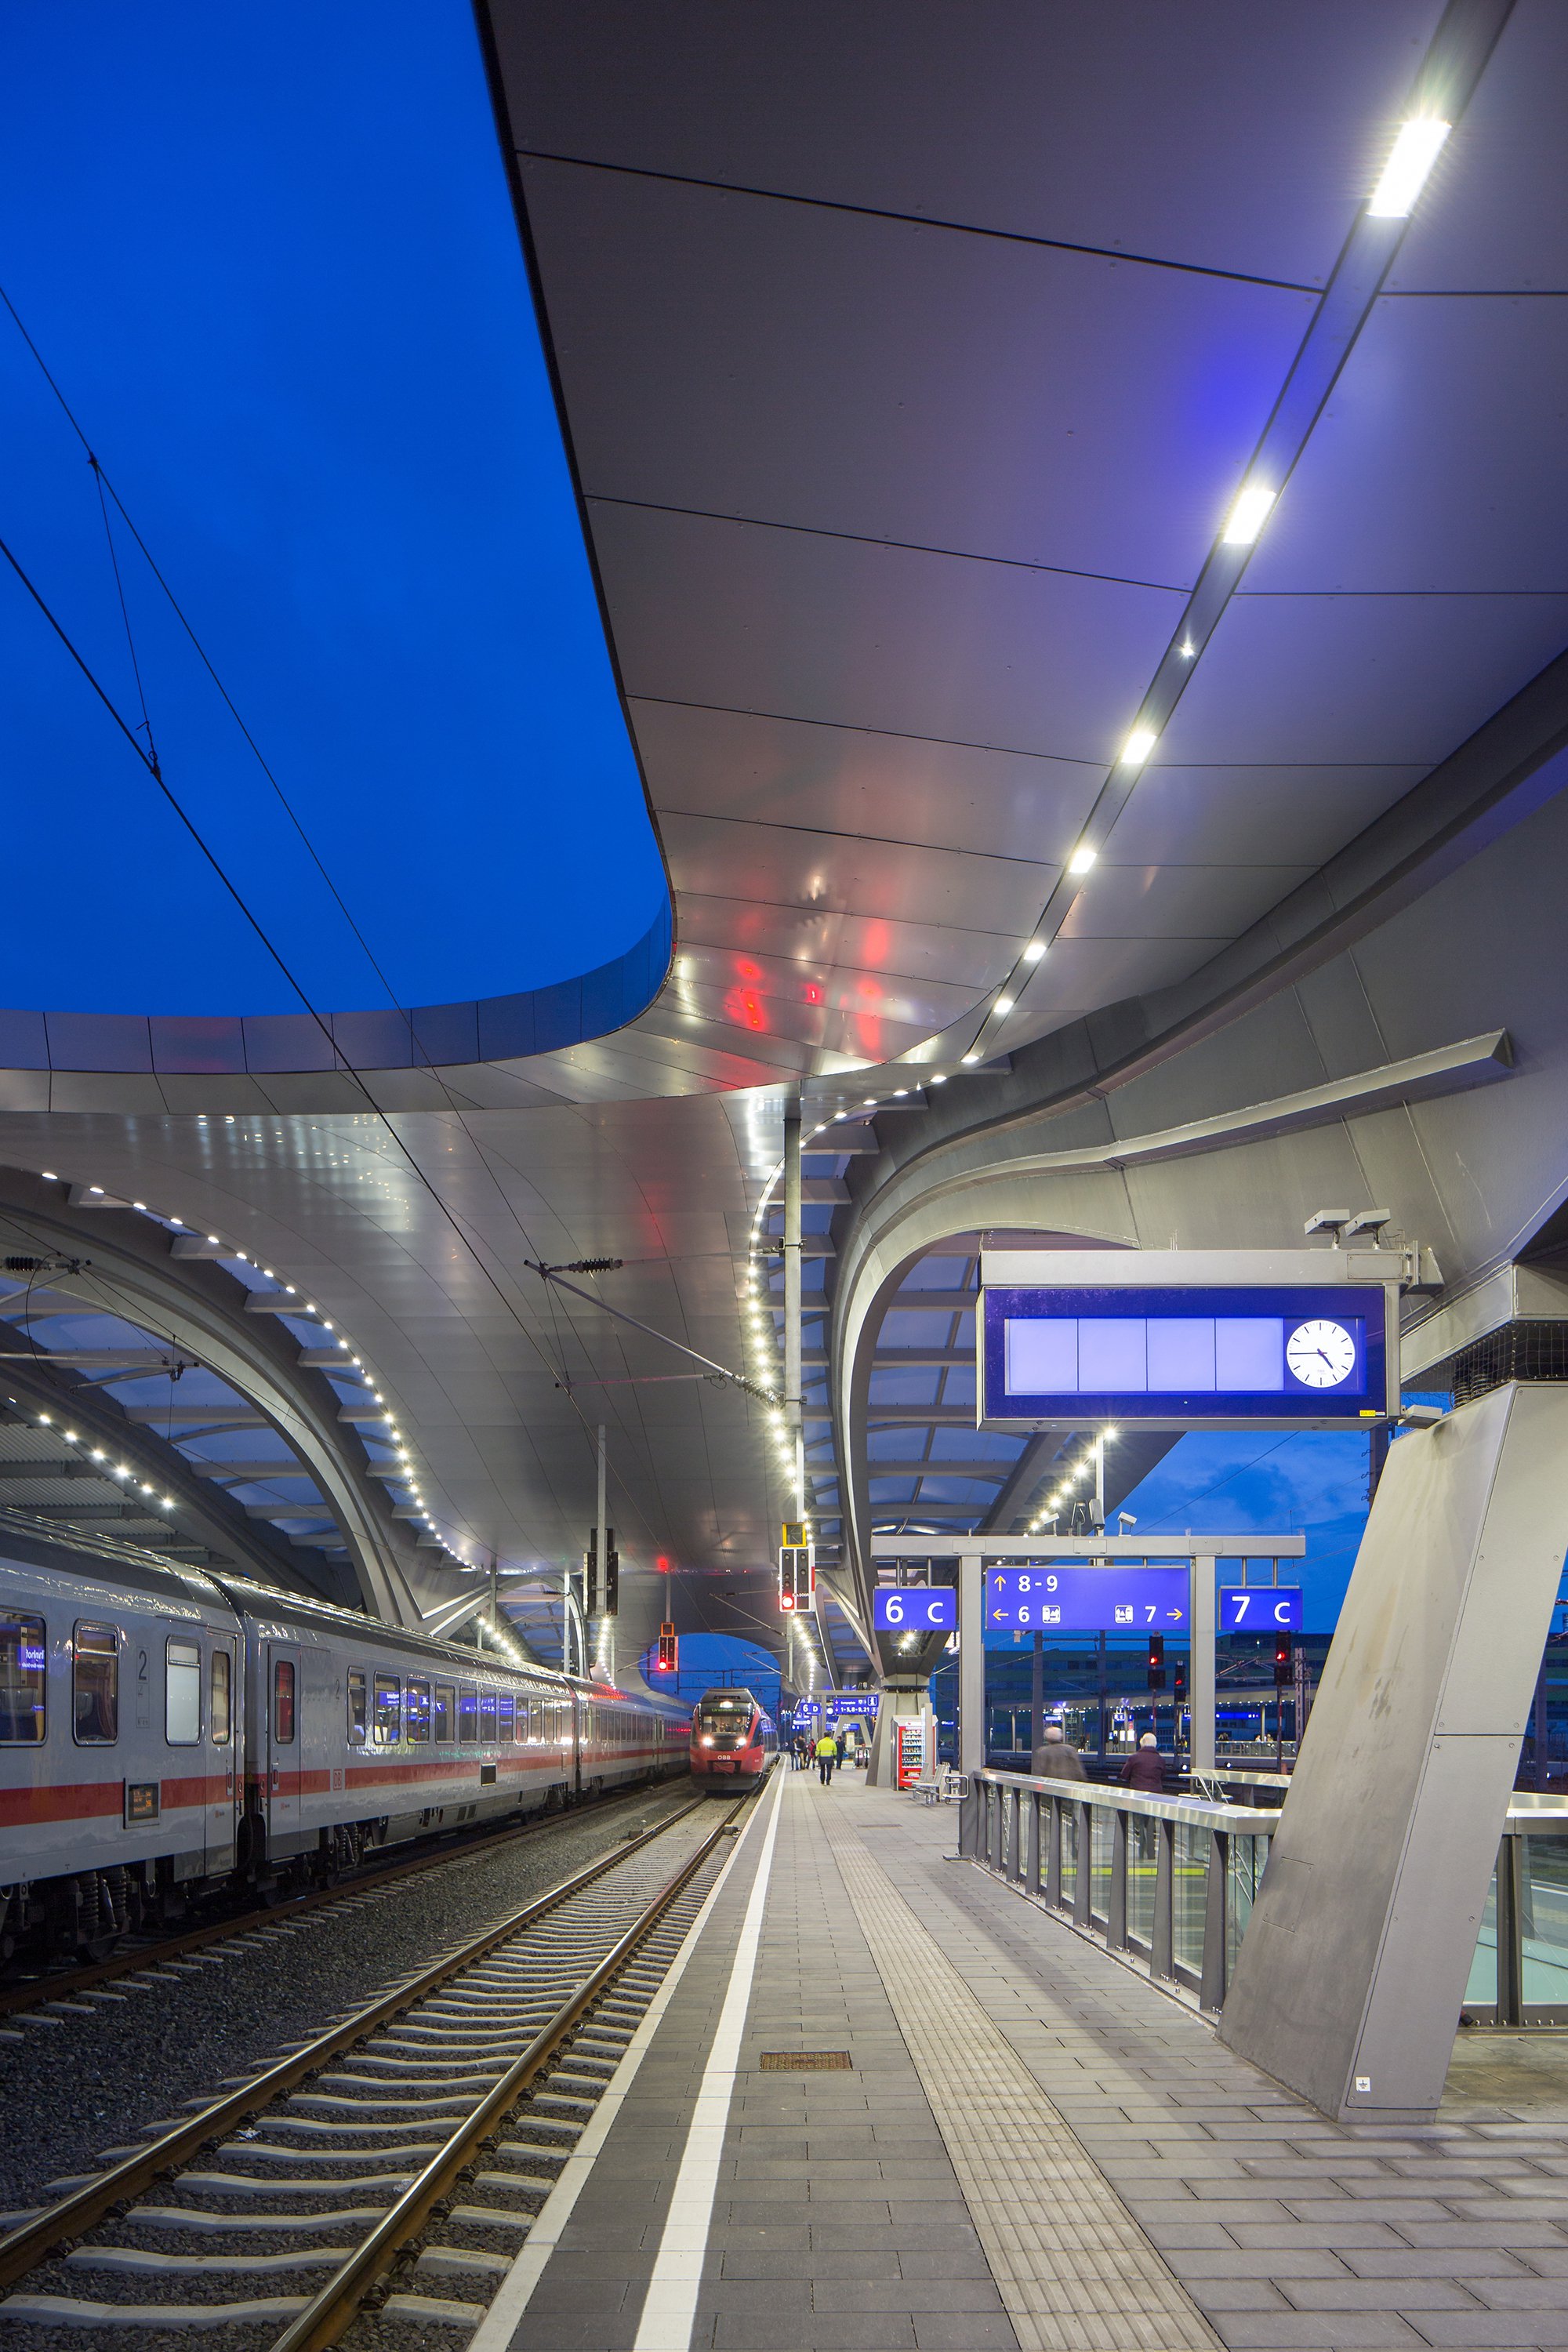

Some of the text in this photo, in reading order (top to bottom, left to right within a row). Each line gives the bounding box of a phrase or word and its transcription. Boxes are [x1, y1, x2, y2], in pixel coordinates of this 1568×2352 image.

[885, 1595, 944, 1624] 6 C
[1018, 1606, 1030, 1623] 6
[1145, 1606, 1157, 1623] 7
[1232, 1596, 1290, 1623] 7 C
[138, 1650, 147, 1681] 2
[802, 1704, 809, 1712] 6
[333, 1769, 342, 1789] DB
